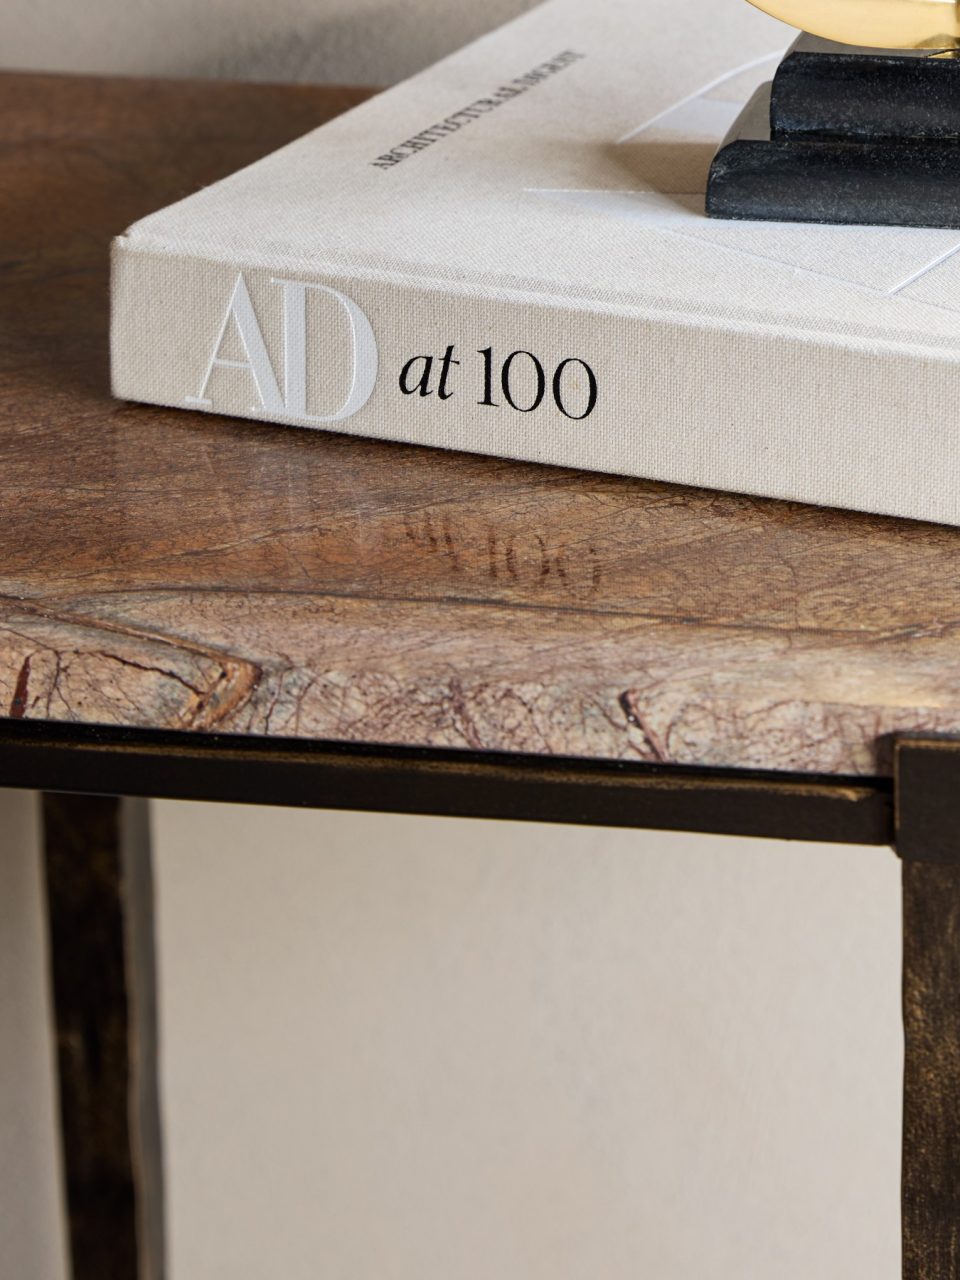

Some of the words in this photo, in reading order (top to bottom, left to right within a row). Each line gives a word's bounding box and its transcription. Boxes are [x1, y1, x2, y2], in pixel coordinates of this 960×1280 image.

[371, 87, 528, 170] ARCHITECTURAL
[184, 271, 379, 422] AD
[399, 345, 461, 400] at
[477, 346, 598, 420] 100
